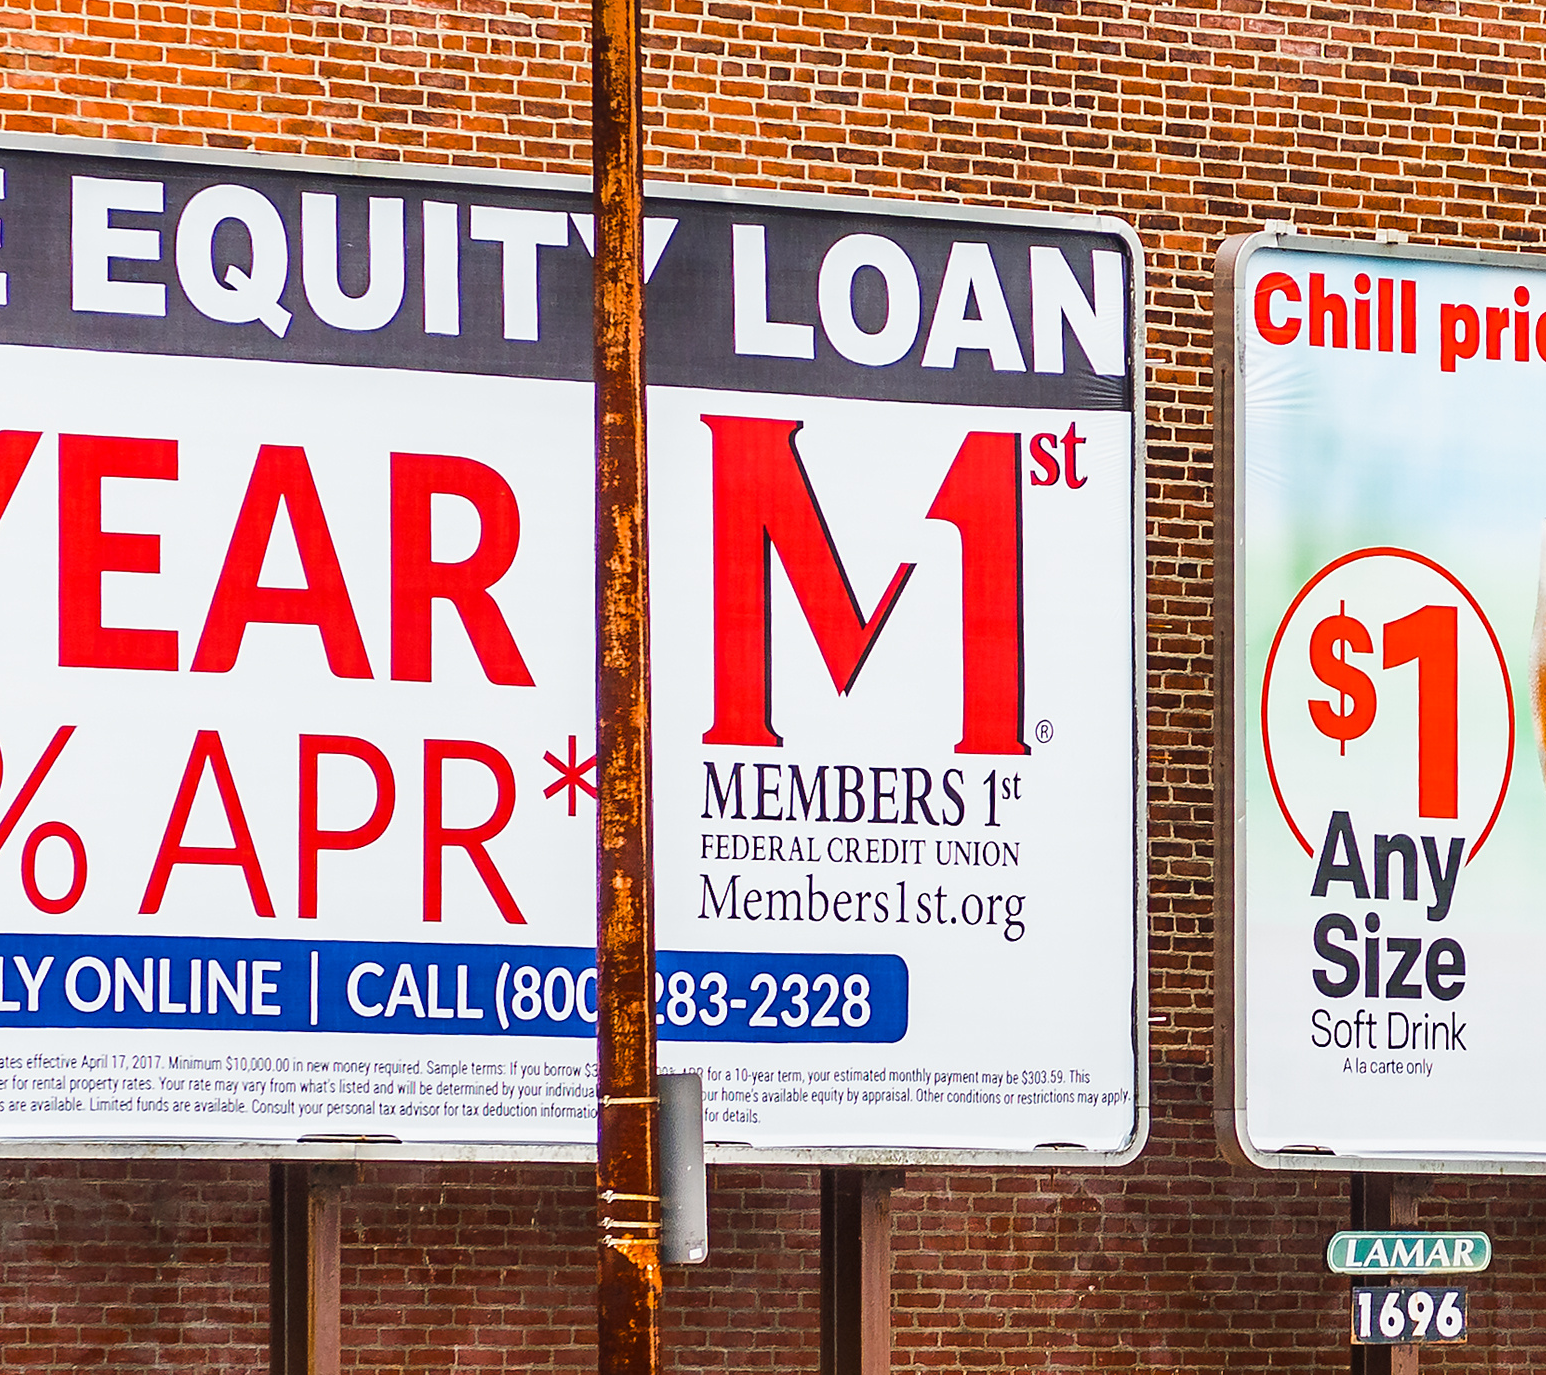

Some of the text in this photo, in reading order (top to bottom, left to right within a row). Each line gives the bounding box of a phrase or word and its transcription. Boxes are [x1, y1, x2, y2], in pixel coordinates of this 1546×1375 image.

[71, 178, 679, 342] EQUIT
[732, 223, 1125, 376] LOAN
[1253, 271, 1417, 355] Chill
[1308, 600, 1460, 821] $1
[700, 761, 1022, 827] MEMBERS 1st
[700, 833, 1020, 867] FEDERAL CREDIT UNION
[1311, 812, 1466, 915] Any
[697, 875, 1027, 939] Members1st.org
[1312, 907, 1466, 1002] Size
[64, 956, 282, 1016] ONLINE
[346, 961, 484, 1019] CALL
[1311, 1008, 1467, 1051] Soft Drink
[26, 1053, 78, 1070] effective
[80, 1054, 108, 1072] April
[111, 1054, 129, 1071] 17,
[131, 1054, 165, 1070] 2017.
[168, 1055, 222, 1071] Minimum
[225, 1055, 290, 1073] $10,000.00
[292, 1060, 304, 1072] in
[306, 1061, 330, 1073] new
[332, 1061, 371, 1077] money
[373, 1059, 423, 1077] required.
[426, 1059, 468, 1079] Sample
[470, 1062, 507, 1076] terms:
[509, 1060, 518, 1076] If
[520, 1064, 541, 1080] you
[543, 1061, 582, 1077] borrow
[707, 1065, 722, 1082] for
[724, 1070, 732, 1082] a
[735, 1067, 775, 1086] 10-year
[777, 1070, 805, 1084] term,
[807, 1071, 831, 1086] your
[833, 1067, 887, 1082] estimated
[888, 1067, 932, 1086] monthly
[934, 1071, 979, 1086] payment
[981, 1073, 1004, 1088] may
[1006, 1070, 1019, 1085] be
[1021, 1069, 1066, 1086] $303.59.
[1069, 1069, 1091, 1084] This
[721, 1086, 1132, 1107] home's available equity by appraisal. Other conditions or restrictions may apply.
[1342, 1057, 1433, 1078] A la carte only
[704, 1107, 761, 1124] for details.
[1345, 1238, 1474, 1267] LAMAR
[1358, 1291, 1463, 1337] 1696
